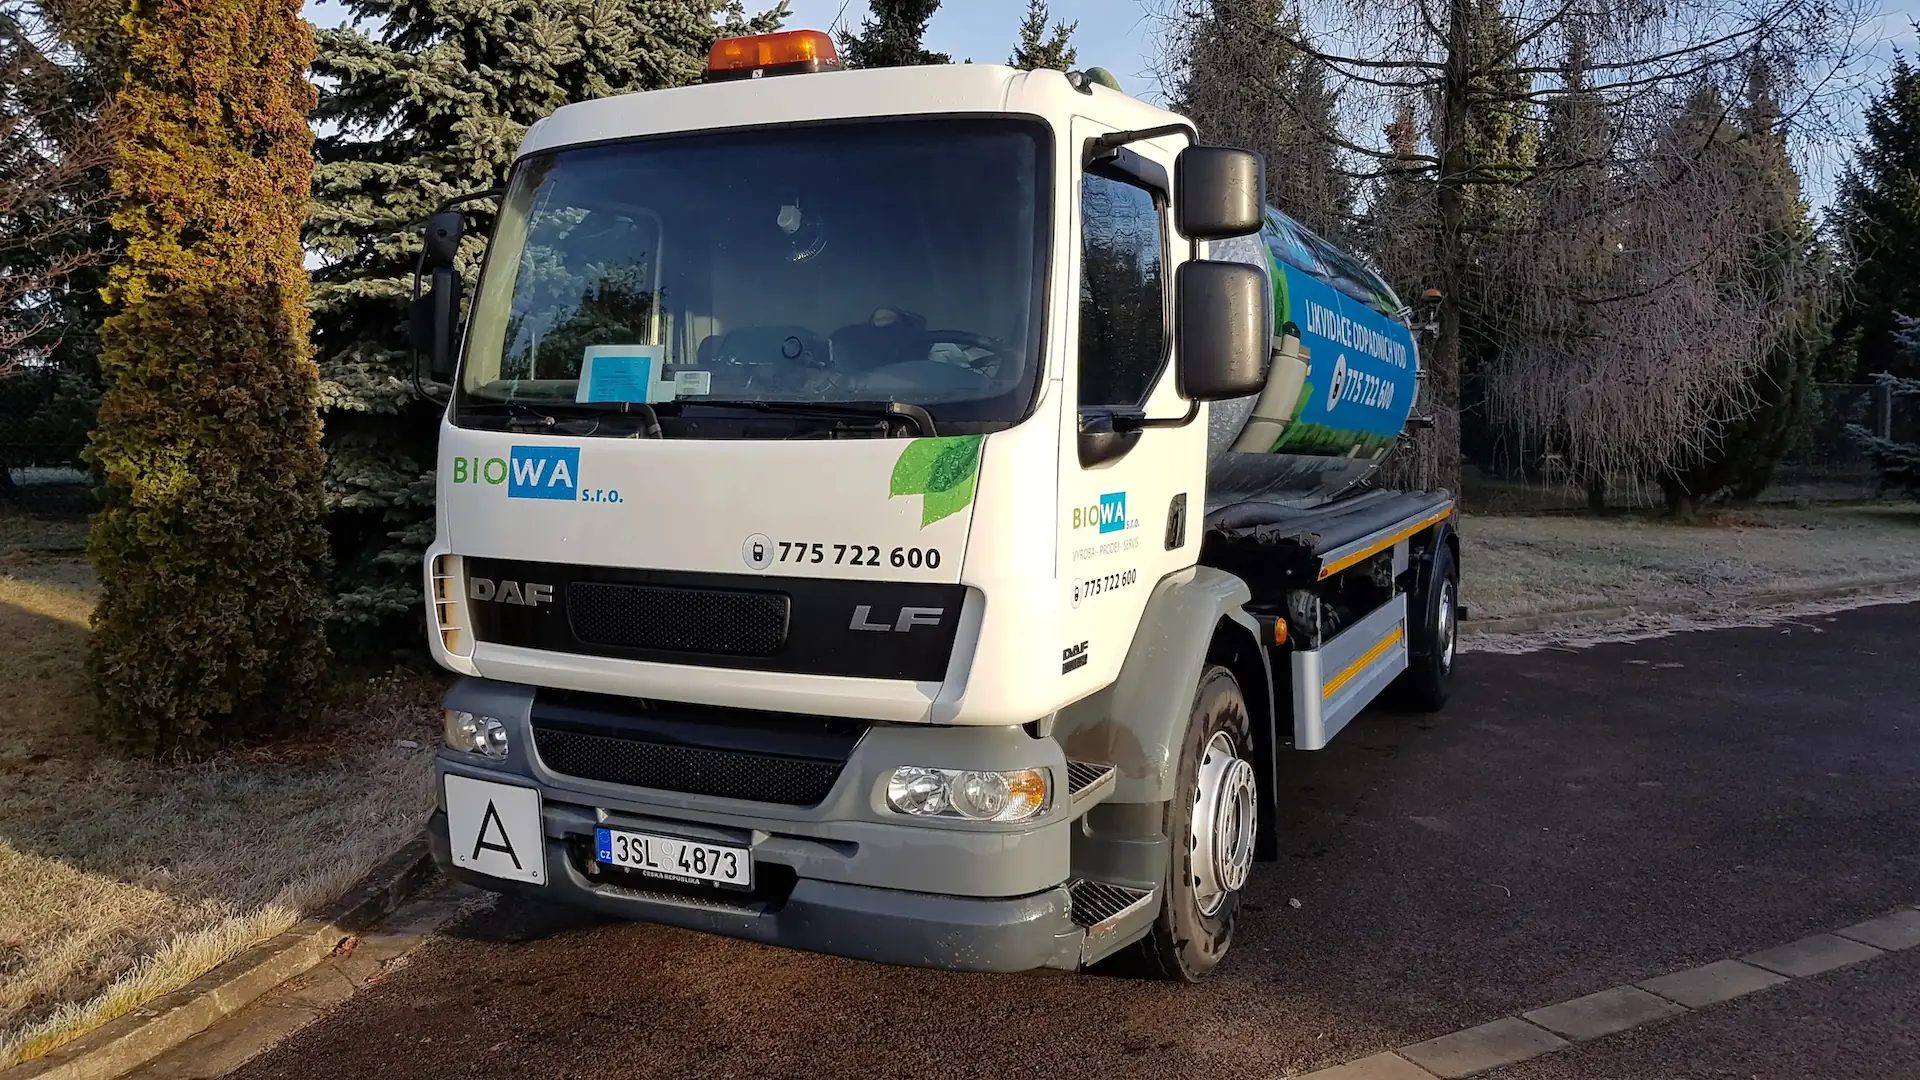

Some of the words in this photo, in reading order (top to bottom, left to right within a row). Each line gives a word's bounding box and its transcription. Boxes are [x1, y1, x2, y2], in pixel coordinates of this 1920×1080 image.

[1305, 299, 1351, 347] LIKVIDACE
[1342, 368, 1364, 403] 775
[1360, 374, 1380, 407] 722
[1376, 380, 1395, 410] 600
[581, 487, 624, 504] s.r.o.
[778, 541, 824, 564] 775
[833, 545, 881, 567] 722
[890, 547, 941, 570] 600
[470, 577, 553, 606] DAF
[1084, 578, 1101, 598] 775
[1104, 573, 1120, 592] 722
[1121, 568, 1136, 586] 600
[848, 605, 944, 633] LF
[1062, 640, 1089, 661] DAF
[472, 798, 523, 870] A
[600, 849, 611, 860] CZ
[616, 835, 658, 868] 3SL
[678, 845, 737, 879] 4873
[664, 873, 700, 885] REPUBLIKA
